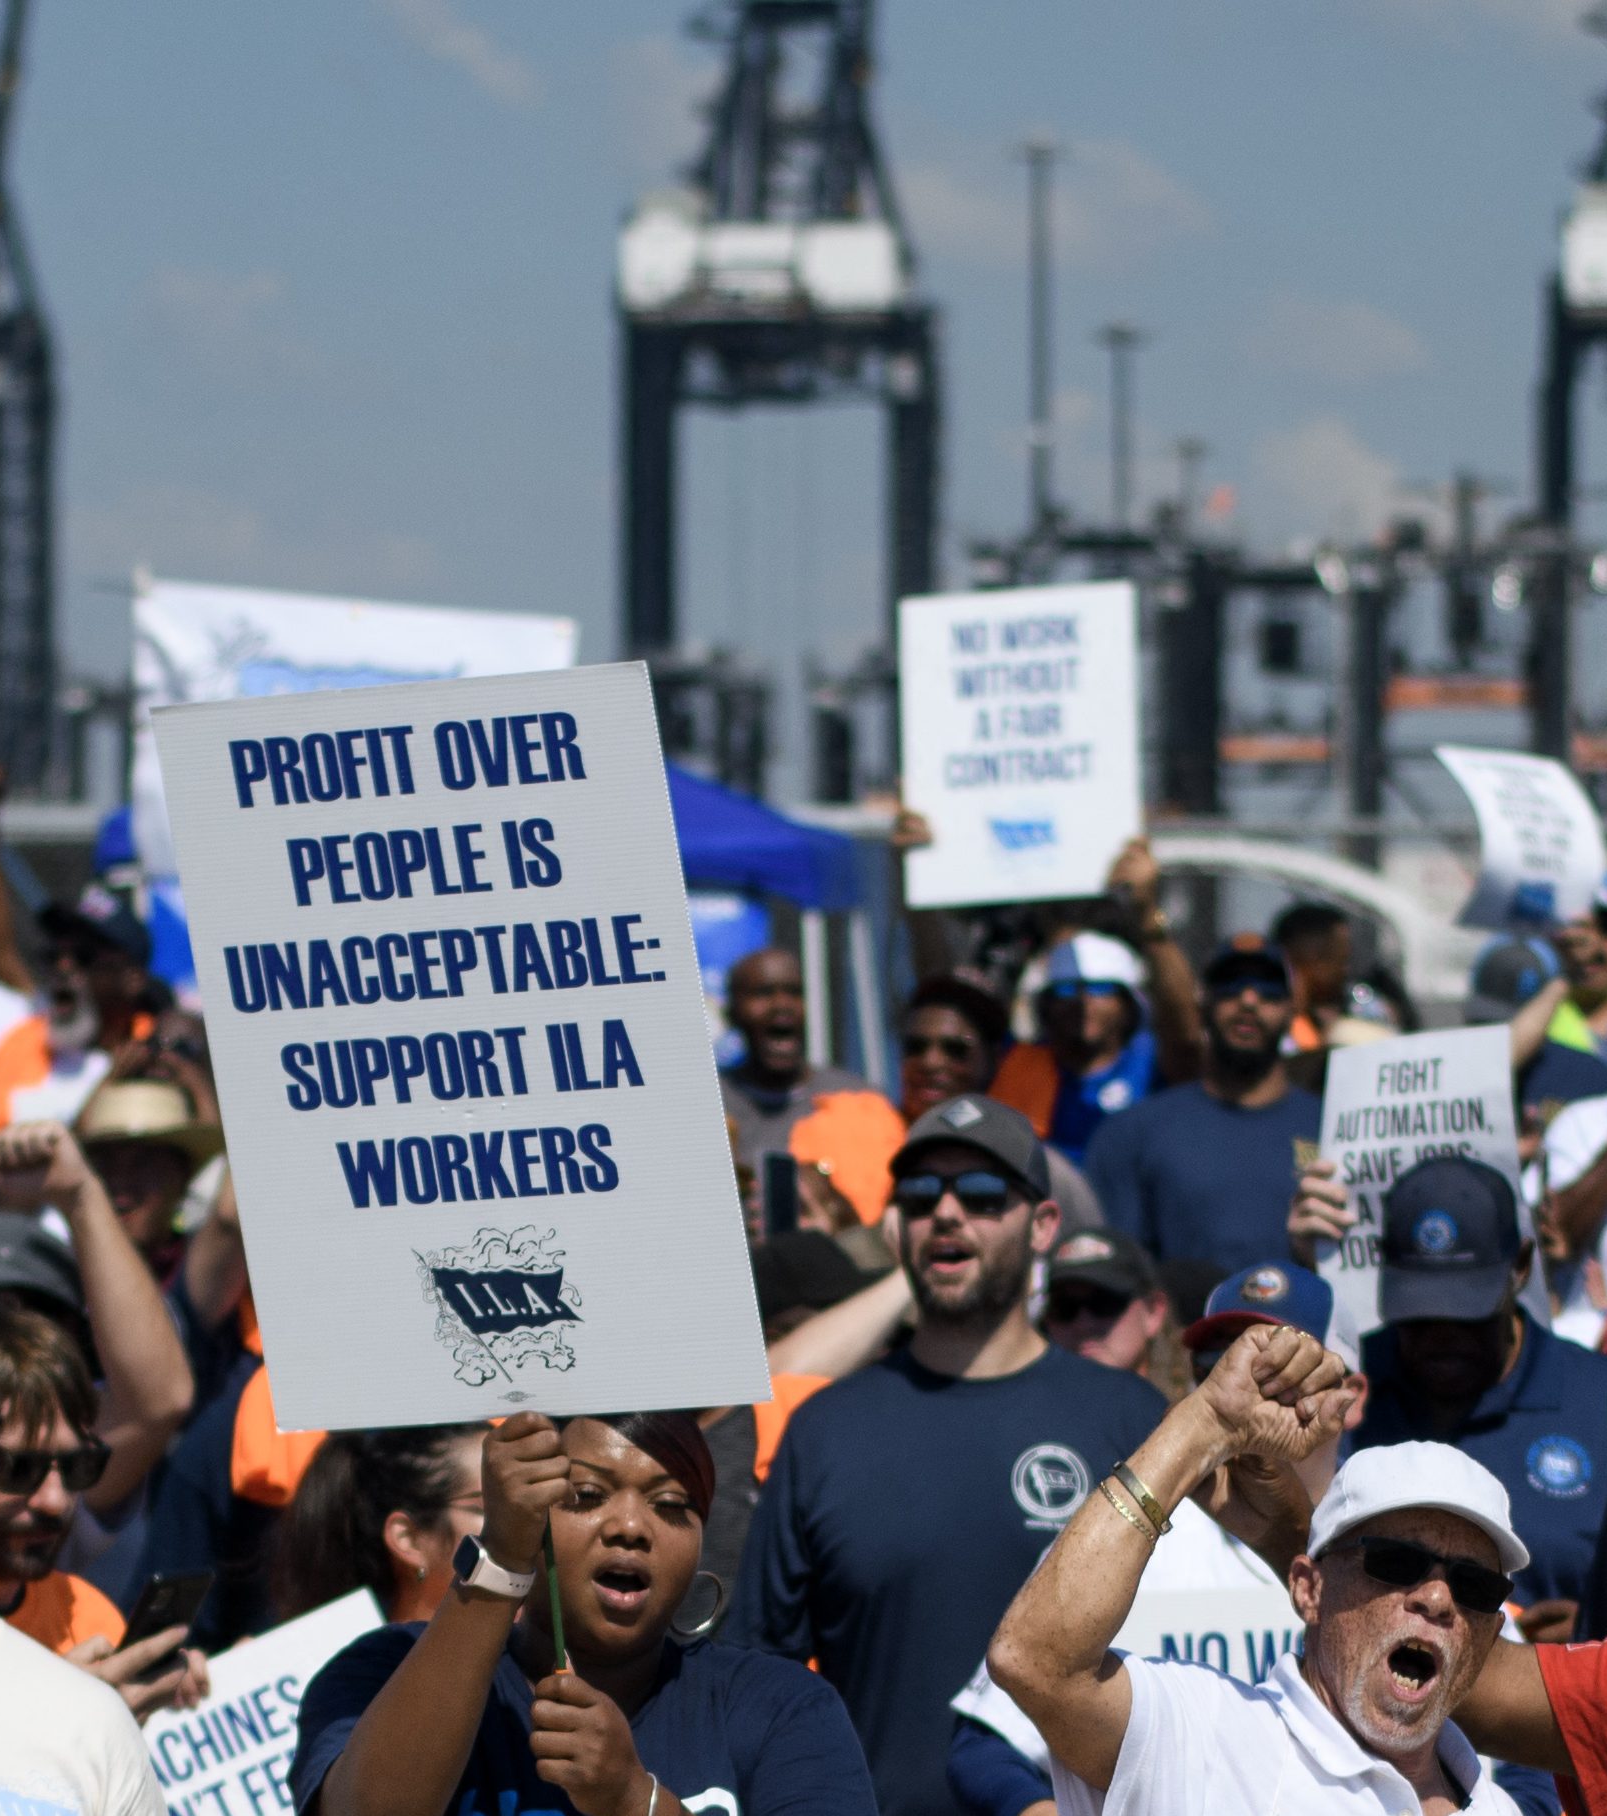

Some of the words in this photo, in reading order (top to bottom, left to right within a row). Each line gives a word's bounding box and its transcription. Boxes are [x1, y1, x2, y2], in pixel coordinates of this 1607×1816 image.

[950, 619, 991, 651] NO
[1000, 612, 1081, 650] WORK
[953, 655, 1080, 697] WITHOUT
[974, 710, 993, 743] A
[998, 705, 1065, 741] FAIR
[228, 726, 414, 809] PROFIT
[433, 711, 587, 797] OVER
[944, 745, 1093, 788] CONTRACT
[285, 822, 493, 908] PEOPLE
[502, 817, 563, 892] IS
[223, 914, 668, 1015] UNACCEPTABLE:
[279, 1025, 528, 1113] SUPPORT
[544, 1018, 646, 1094] ILA
[1377, 1058, 1442, 1096] FIGHT
[1334, 1097, 1494, 1142] AUTOMATION,
[335, 1122, 620, 1210] WORKERS
[1343, 1147, 1403, 1185] SAVE
[458, 1278, 562, 1321] I.L.A.
[1161, 1630, 1229, 1674] NO
[150, 1674, 302, 1787] ACHINES
